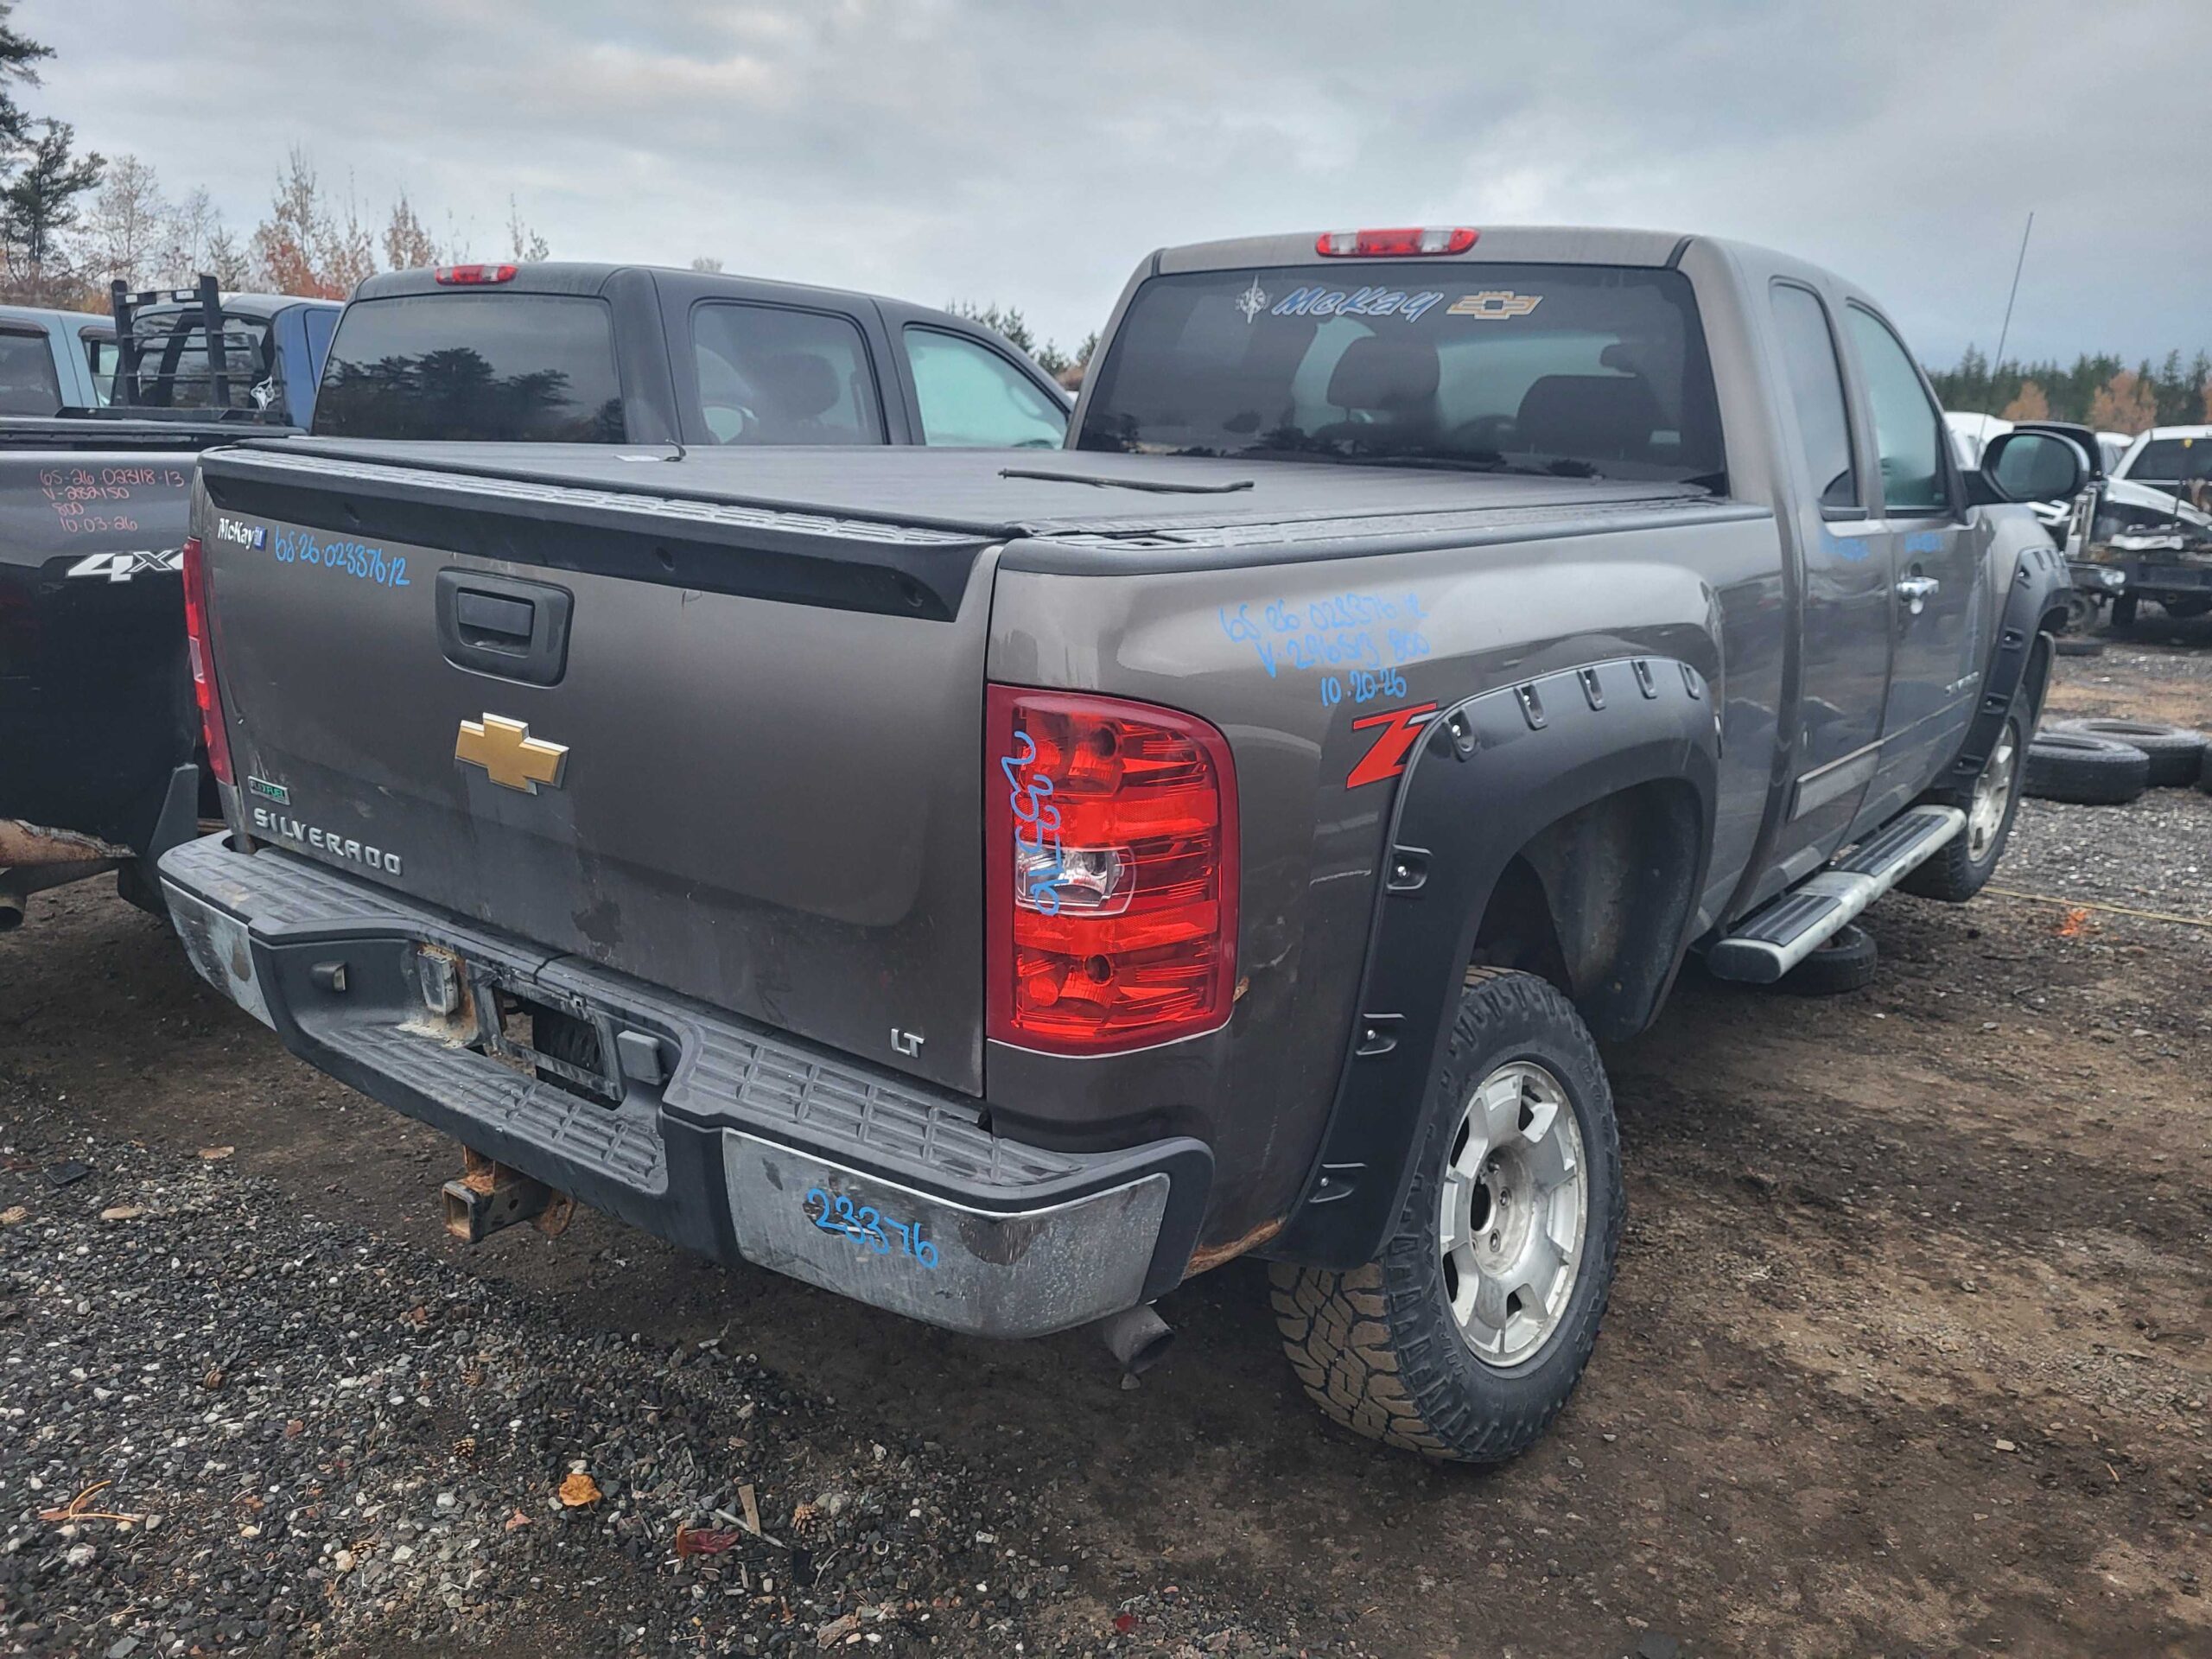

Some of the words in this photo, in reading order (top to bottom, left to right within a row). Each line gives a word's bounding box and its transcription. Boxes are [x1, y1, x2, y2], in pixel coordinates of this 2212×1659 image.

[1272, 286, 1445, 323] McKay
[218, 518, 254, 550] McKay
[253, 807, 403, 876] SILVERADO
[891, 1028, 925, 1058] LT
[806, 1187, 939, 1269] 23376
